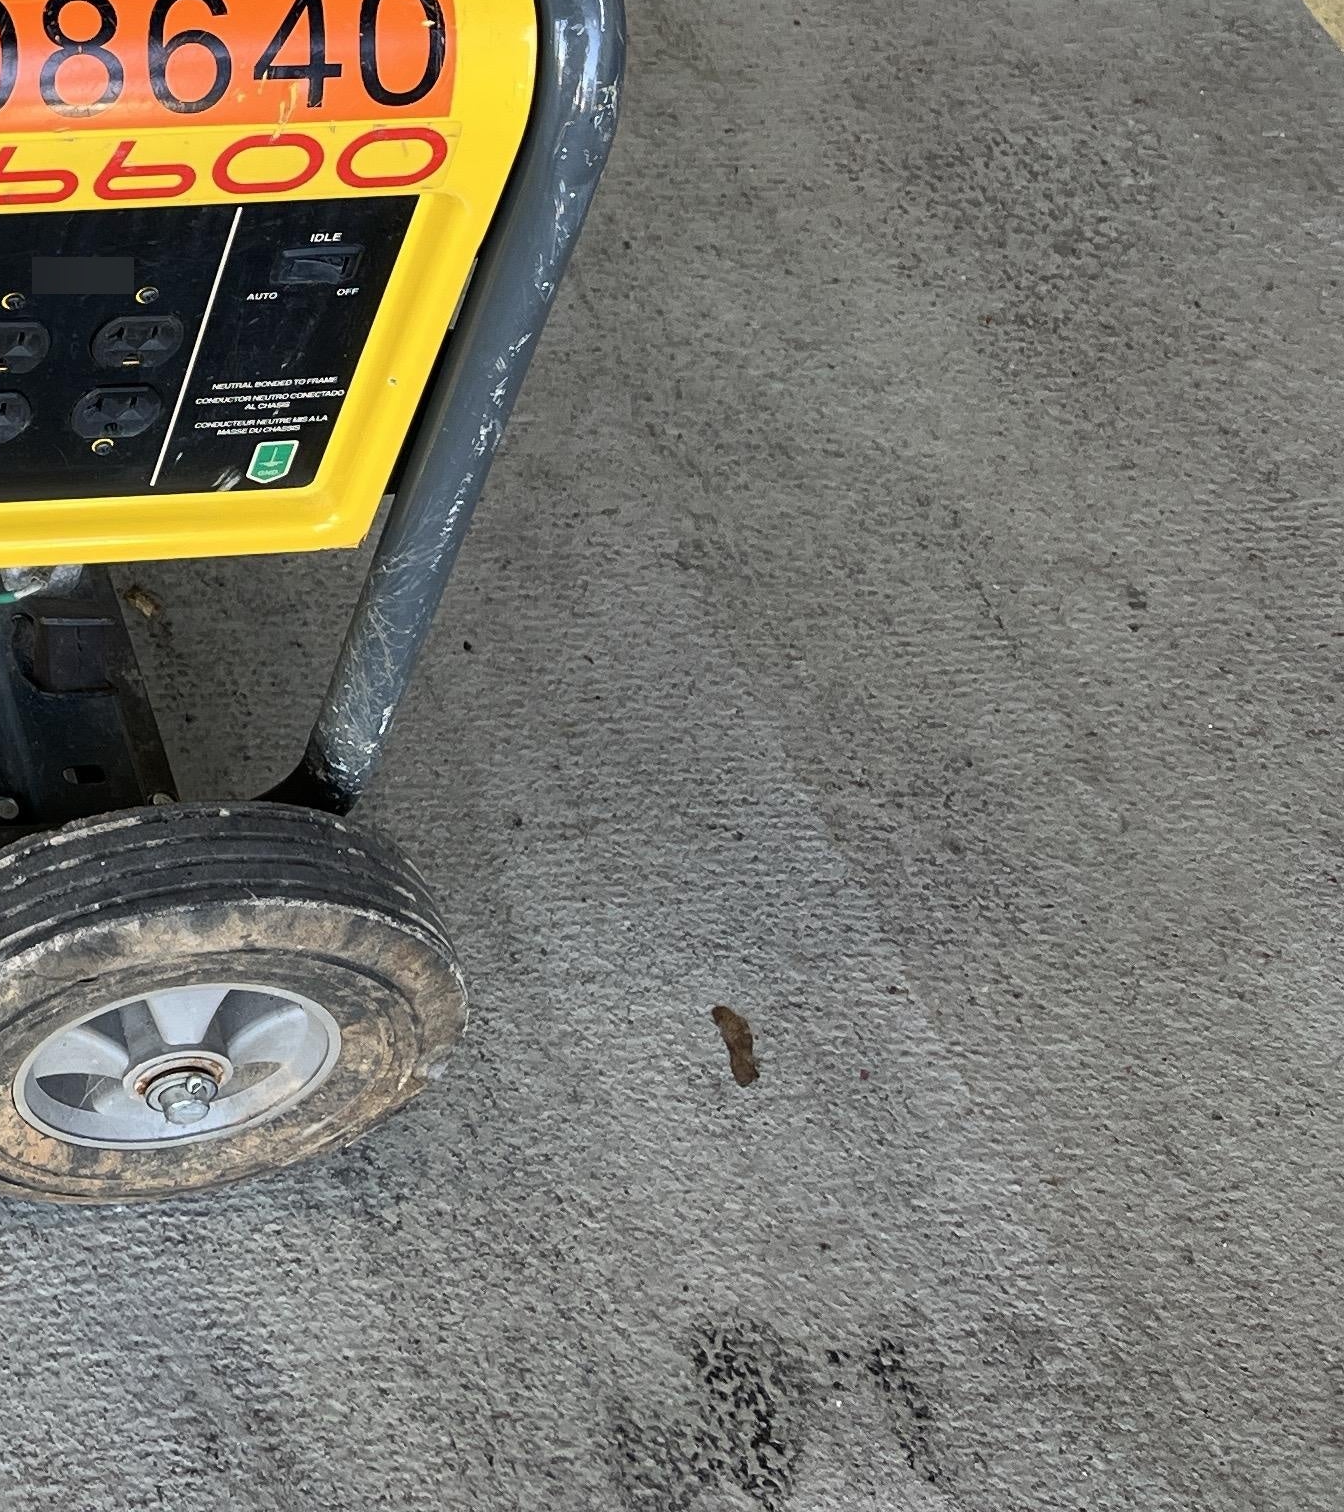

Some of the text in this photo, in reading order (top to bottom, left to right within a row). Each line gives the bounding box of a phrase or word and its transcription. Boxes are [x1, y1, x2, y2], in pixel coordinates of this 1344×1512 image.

[309, 231, 343, 243] IDLE
[247, 290, 278, 302] AUTO
[336, 287, 360, 297] OFF
[212, 376, 339, 390] NEUTRAL BONDED TO FRAME
[195, 389, 345, 405] CONDUCTOR NEUTRO CONECTADO
